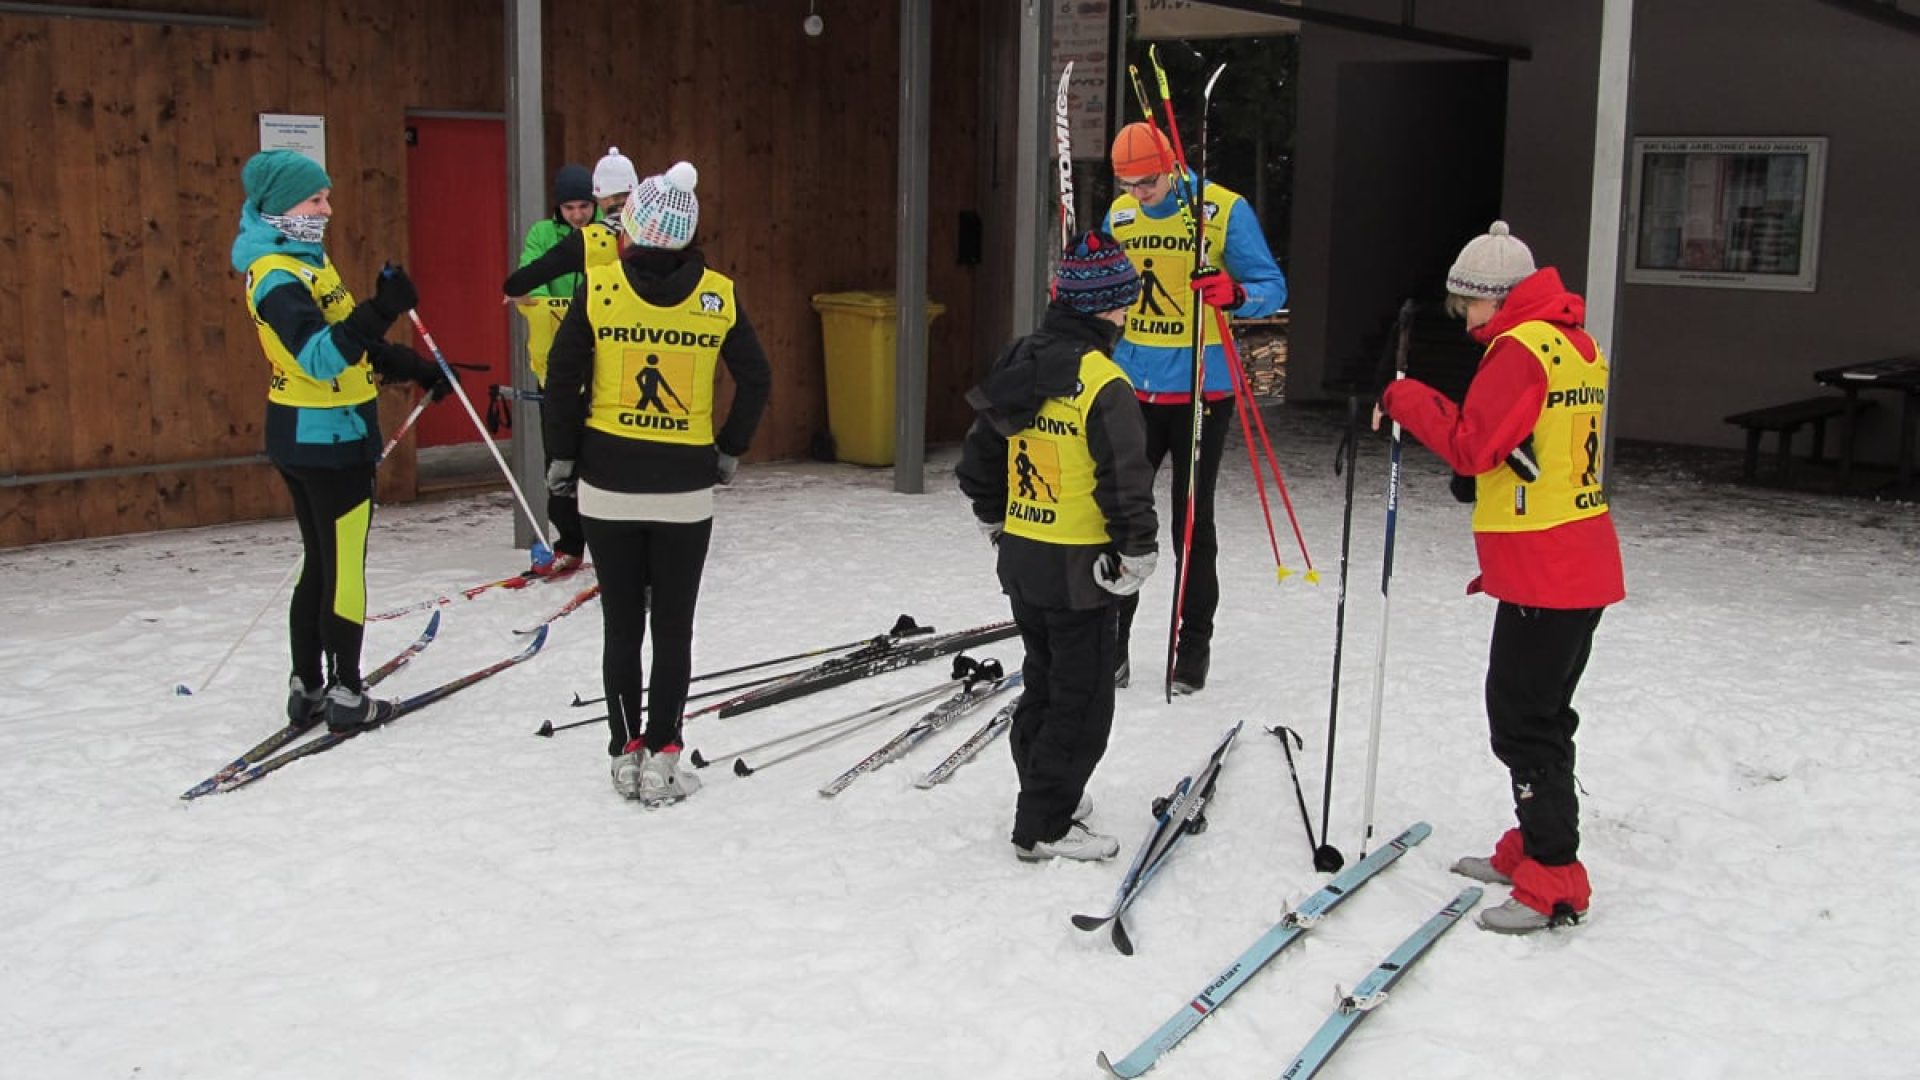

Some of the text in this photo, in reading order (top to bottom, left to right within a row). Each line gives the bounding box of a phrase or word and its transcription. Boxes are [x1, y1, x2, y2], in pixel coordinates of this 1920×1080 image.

[1057, 92, 1074, 212] ATOMIC
[597, 322, 721, 348] PRŮVODCE
[1131, 318, 1184, 335] BLIND
[618, 413, 689, 431] GUIDE
[1008, 501, 1057, 524] BLIND
[1204, 963, 1243, 996] Polar
